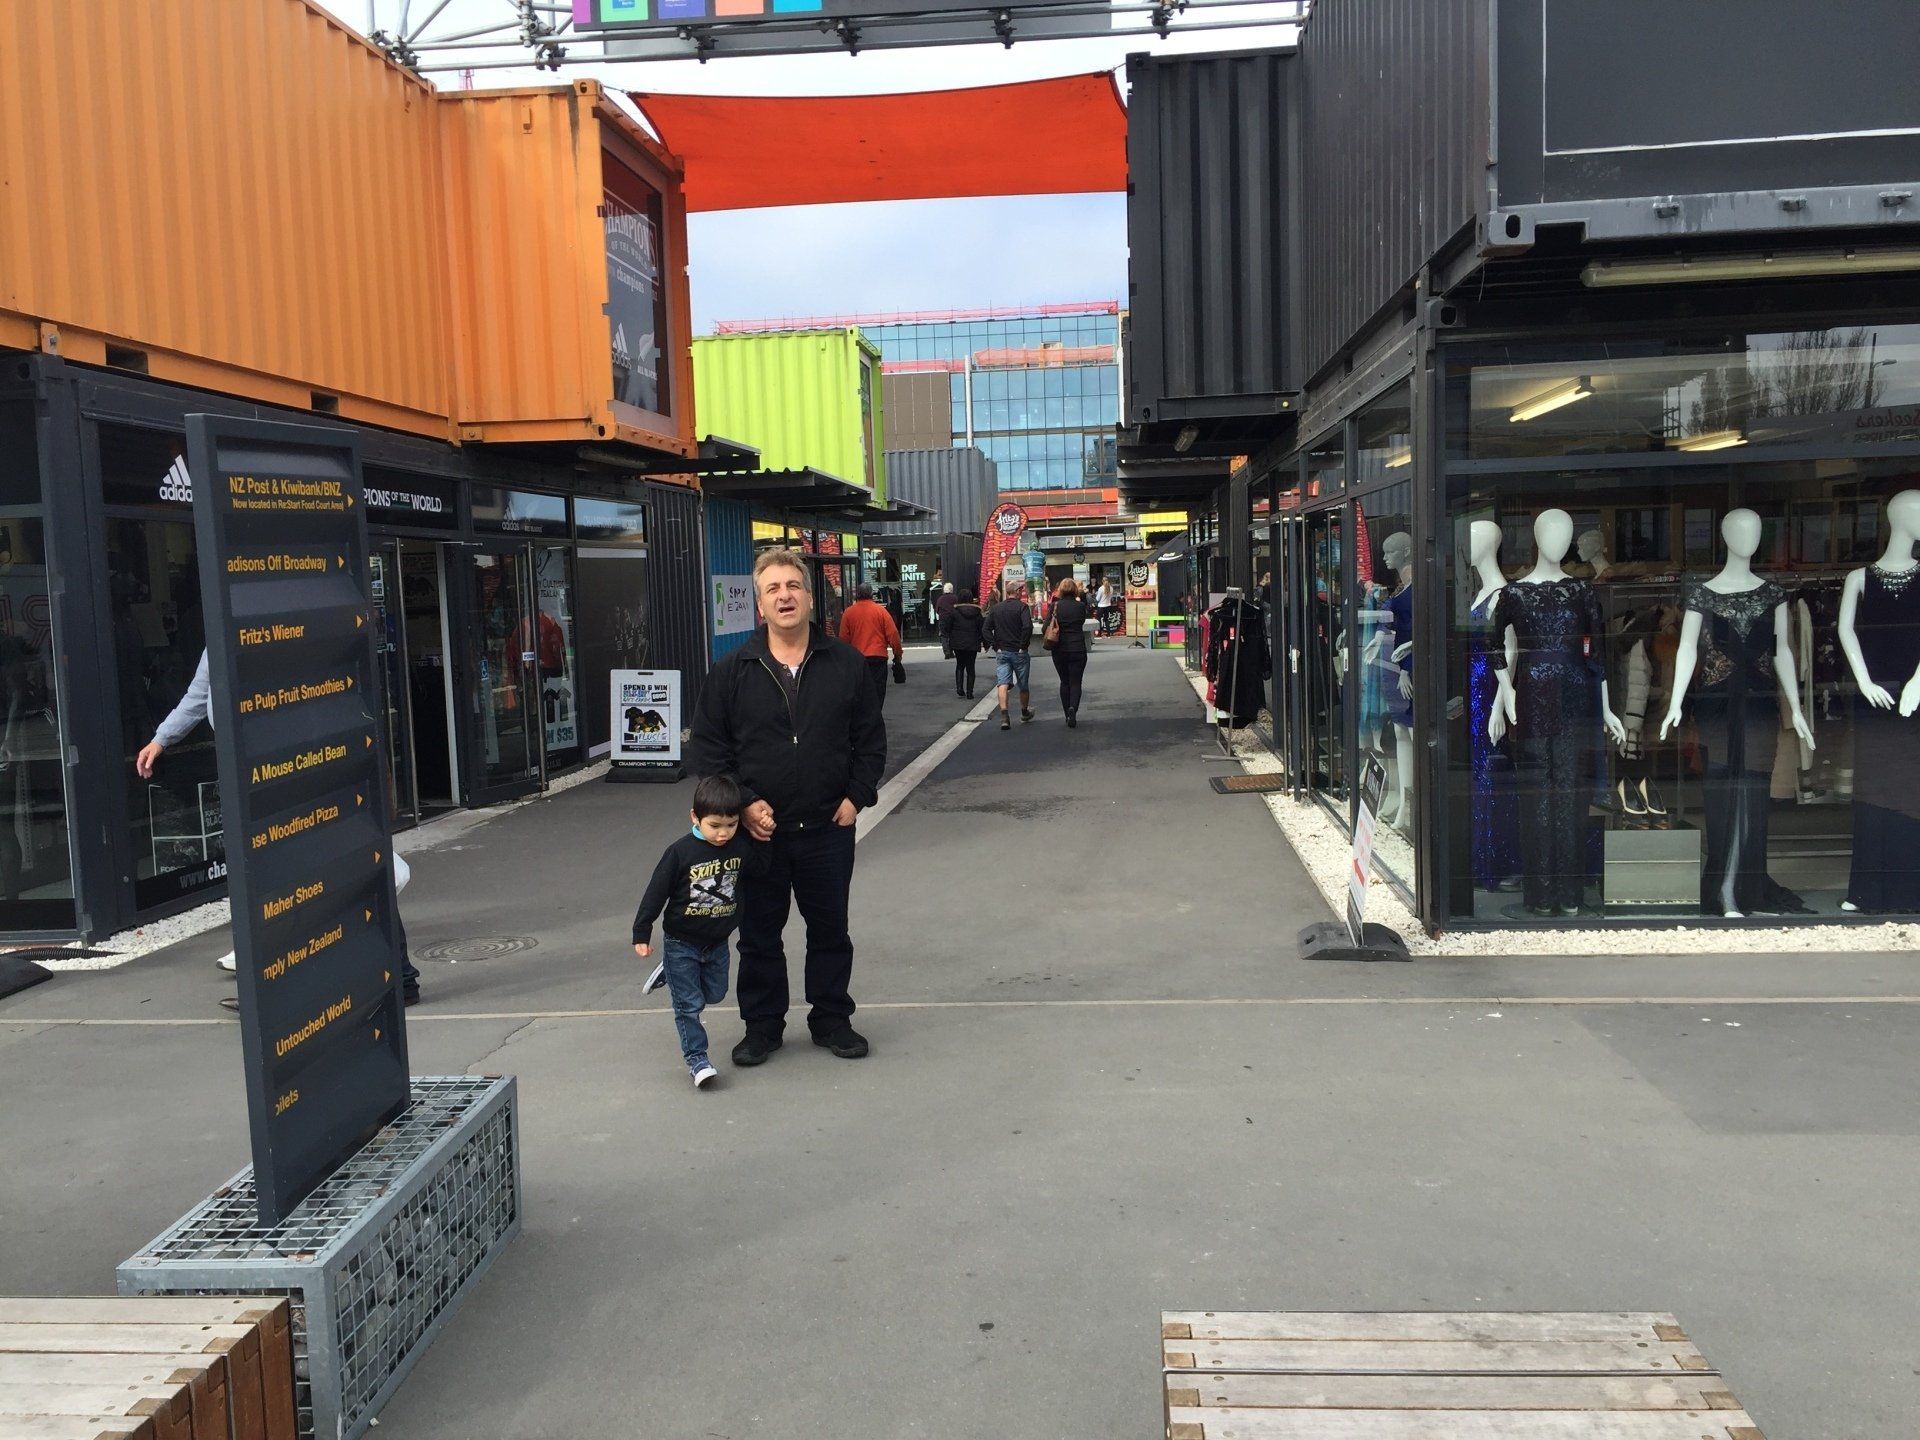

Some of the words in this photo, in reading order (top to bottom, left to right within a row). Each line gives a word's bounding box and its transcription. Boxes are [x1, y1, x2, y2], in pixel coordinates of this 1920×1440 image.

[229, 476, 246, 494] NZ
[246, 477, 270, 494] Post
[271, 478, 280, 495] &
[280, 479, 342, 496] Kiwibank/BNZ
[232, 498, 248, 509] Now
[248, 498, 271, 509] located
[271, 499, 278, 509] in
[301, 500, 315, 510] Food
[315, 500, 331, 510] Court
[391, 491, 399, 501] OF
[399, 492, 410, 503] THE
[410, 493, 442, 513] WORLD
[227, 556, 266, 573] adisons
[267, 555, 282, 572] Off
[283, 555, 327, 573] Broadway
[863, 560, 887, 568] INITE
[901, 564, 918, 573] DEF
[901, 573, 926, 582] INITE
[239, 626, 271, 646] Fritz's
[271, 624, 305, 641] Wiener
[254, 693, 277, 710] Pulp
[278, 687, 301, 705] Fruit
[300, 679, 345, 699] Smoothies
[557, 726, 574, 743] $35
[252, 767, 261, 784] A
[261, 761, 294, 781] Mouse
[295, 748, 324, 770] Called
[324, 744, 347, 761] Bean
[268, 811, 315, 842] Woodfired
[315, 805, 339, 824] Pizza
[689, 862, 721, 881] SKATE
[723, 857, 742, 871] CITY
[263, 894, 296, 921] Maher
[295, 881, 324, 904] Shoes
[684, 906, 711, 916] BOARD
[287, 946, 308, 968] New
[308, 923, 343, 955] Zealand
[276, 1011, 326, 1057] Untouched
[326, 994, 353, 1023] World
